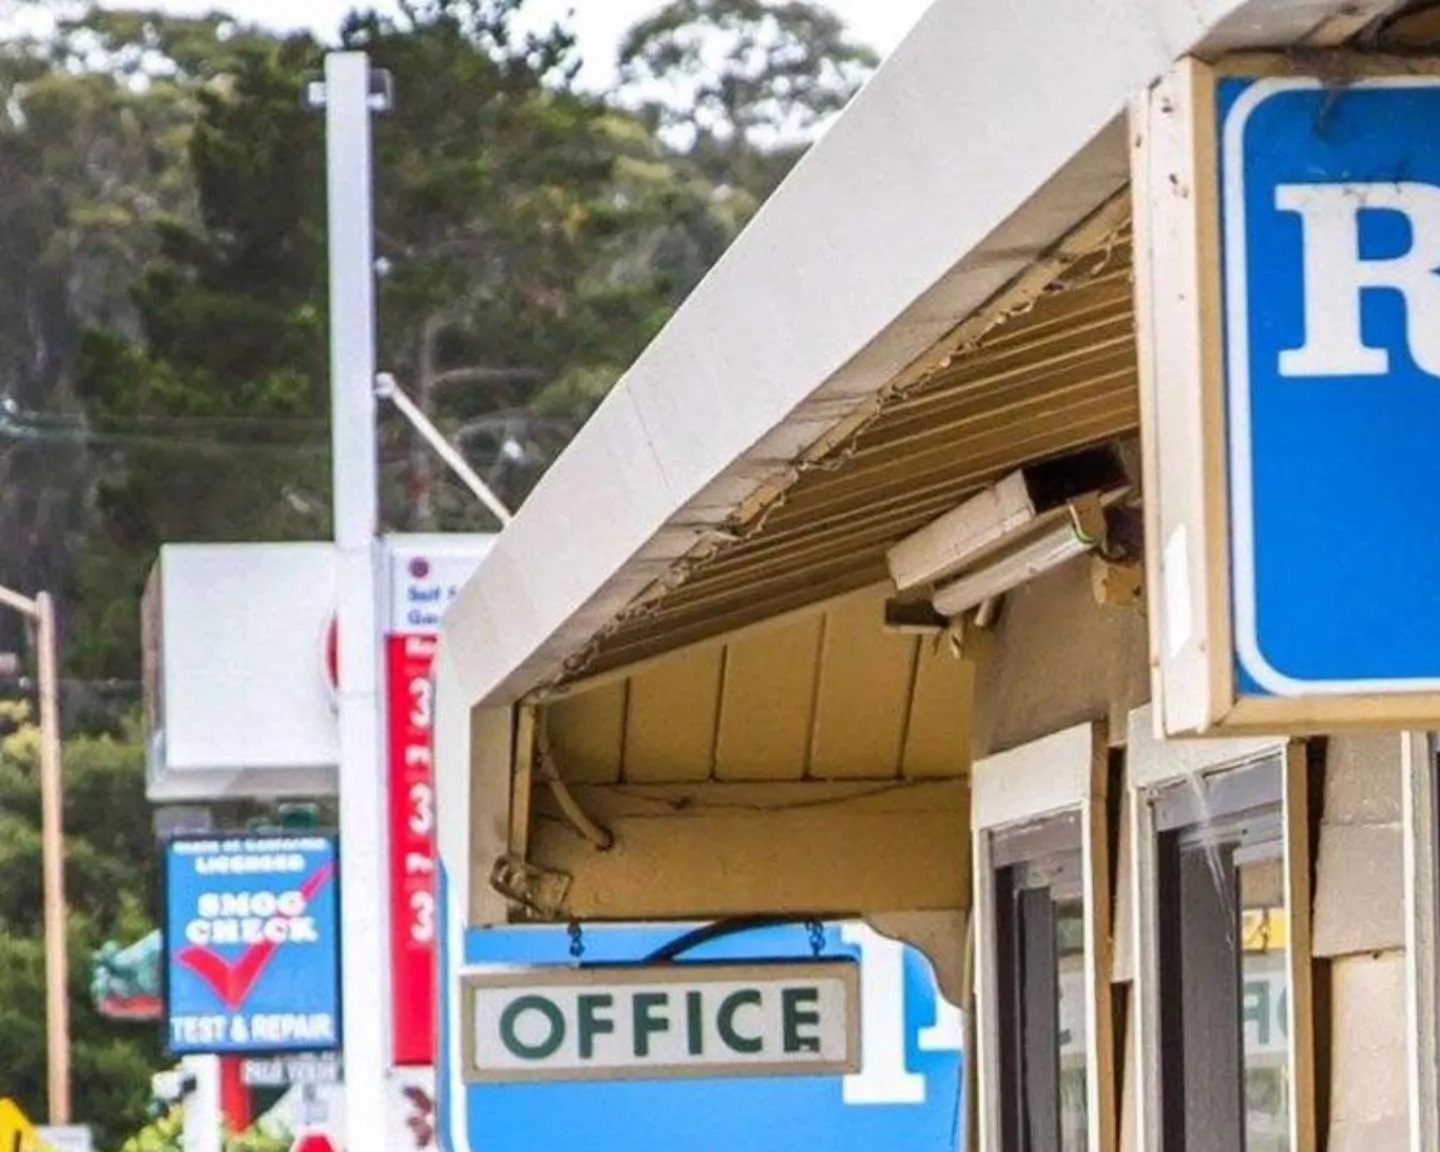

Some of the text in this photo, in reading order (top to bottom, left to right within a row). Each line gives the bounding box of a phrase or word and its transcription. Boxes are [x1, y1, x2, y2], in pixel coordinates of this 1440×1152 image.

[198, 890, 307, 918] SMOG
[185, 916, 319, 945] CHECK
[169, 1013, 332, 1043] TEST & REPAIR
[500, 987, 820, 1060] OFFICE
